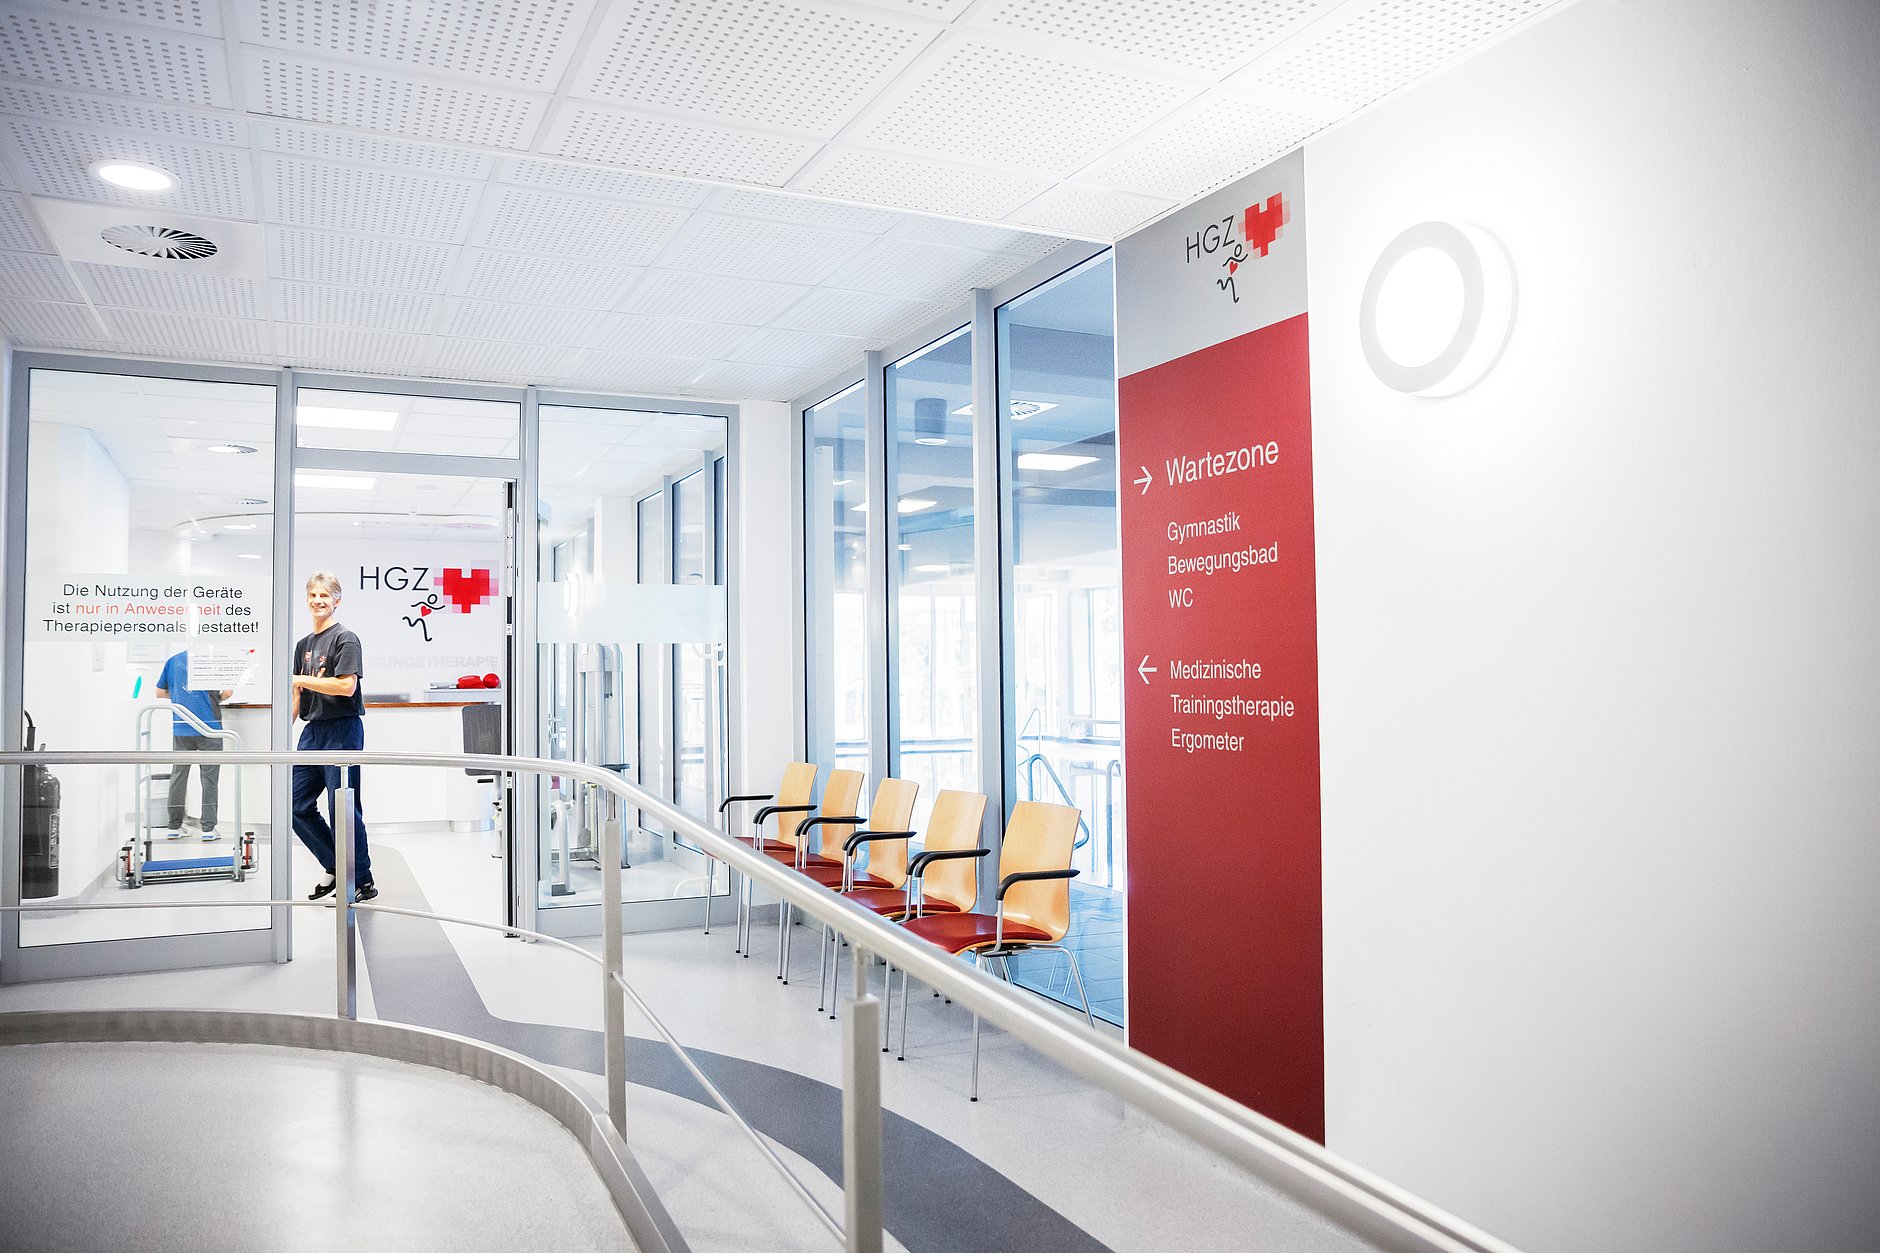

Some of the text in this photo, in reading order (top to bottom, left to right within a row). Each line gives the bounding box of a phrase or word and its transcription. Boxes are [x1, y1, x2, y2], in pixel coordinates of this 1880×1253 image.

[1186, 214, 1236, 264] HGZ
[1165, 440, 1280, 487] Wartezone
[1167, 511, 1241, 545] Gymnastik
[1168, 541, 1279, 576] Bewegungsbad
[360, 565, 430, 591] HGZ
[63, 583, 243, 601] Die Nutzung der Geräte
[1168, 587, 1194, 609] WC
[52, 601, 70, 614] ist
[75, 604, 101, 615] nur
[106, 602, 119, 615] in
[225, 603, 252, 616] des
[43, 619, 259, 636] Therapiepersonals estattet!
[1170, 658, 1262, 680] Medizinische
[1170, 694, 1295, 722] Trainingstherapie
[1171, 727, 1245, 754] Ergometer
